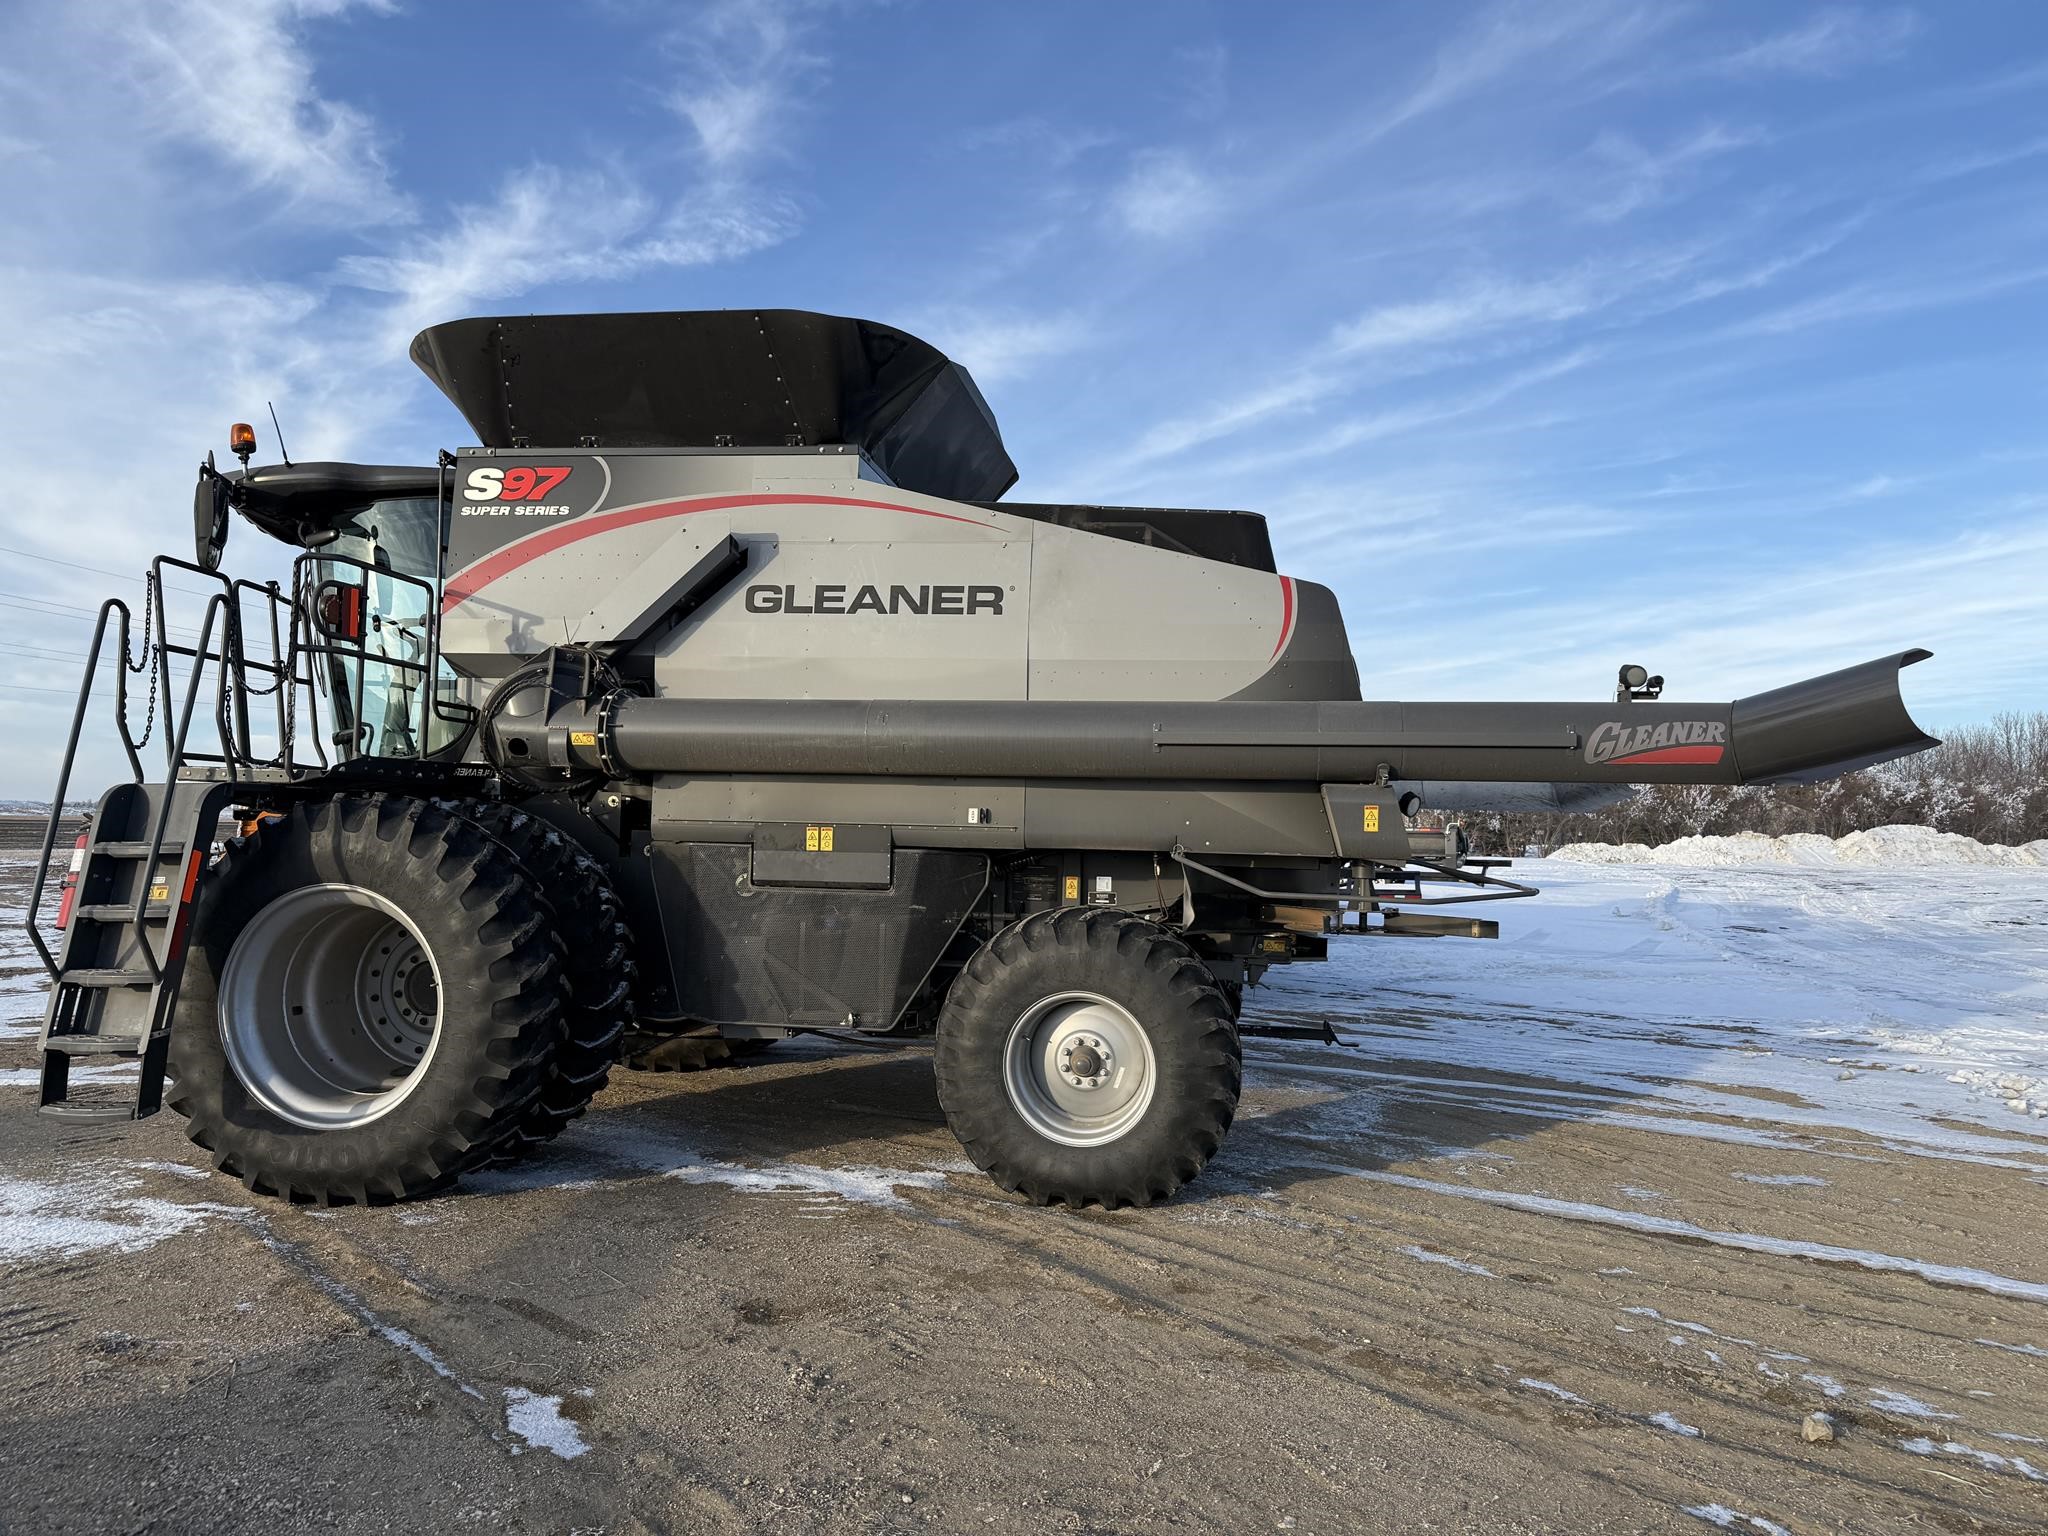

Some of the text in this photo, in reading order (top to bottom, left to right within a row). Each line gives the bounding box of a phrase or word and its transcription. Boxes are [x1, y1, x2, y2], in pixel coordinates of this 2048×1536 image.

[463, 466, 572, 501] S97
[460, 505, 570, 516] SUPER SERIES
[745, 584, 1004, 615] GLEANER
[1584, 721, 1726, 765] GLEANER
